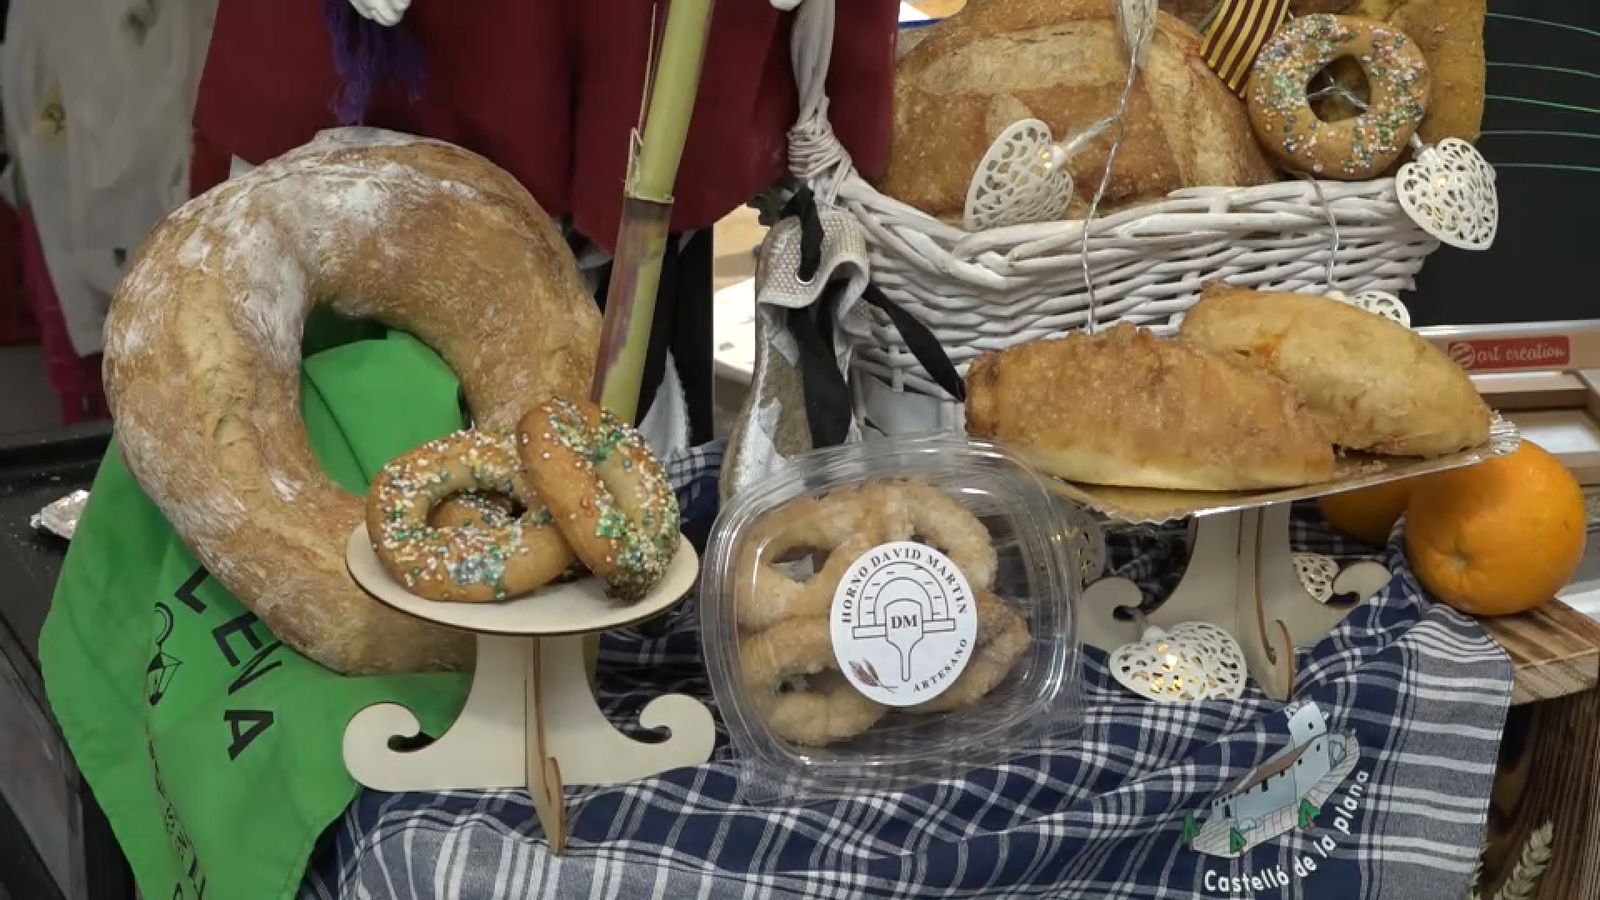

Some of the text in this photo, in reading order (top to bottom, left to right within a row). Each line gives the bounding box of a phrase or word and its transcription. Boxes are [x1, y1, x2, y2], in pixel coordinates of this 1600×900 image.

[1477, 343, 1566, 363] art creation
[841, 548, 968, 624] HORNO DAVID MARTIN
[891, 614, 918, 629] DM
[913, 638, 968, 693] ARTESANO
[1294, 855, 1317, 877] de
[1312, 834, 1337, 858] la
[1333, 770, 1369, 836] plana
